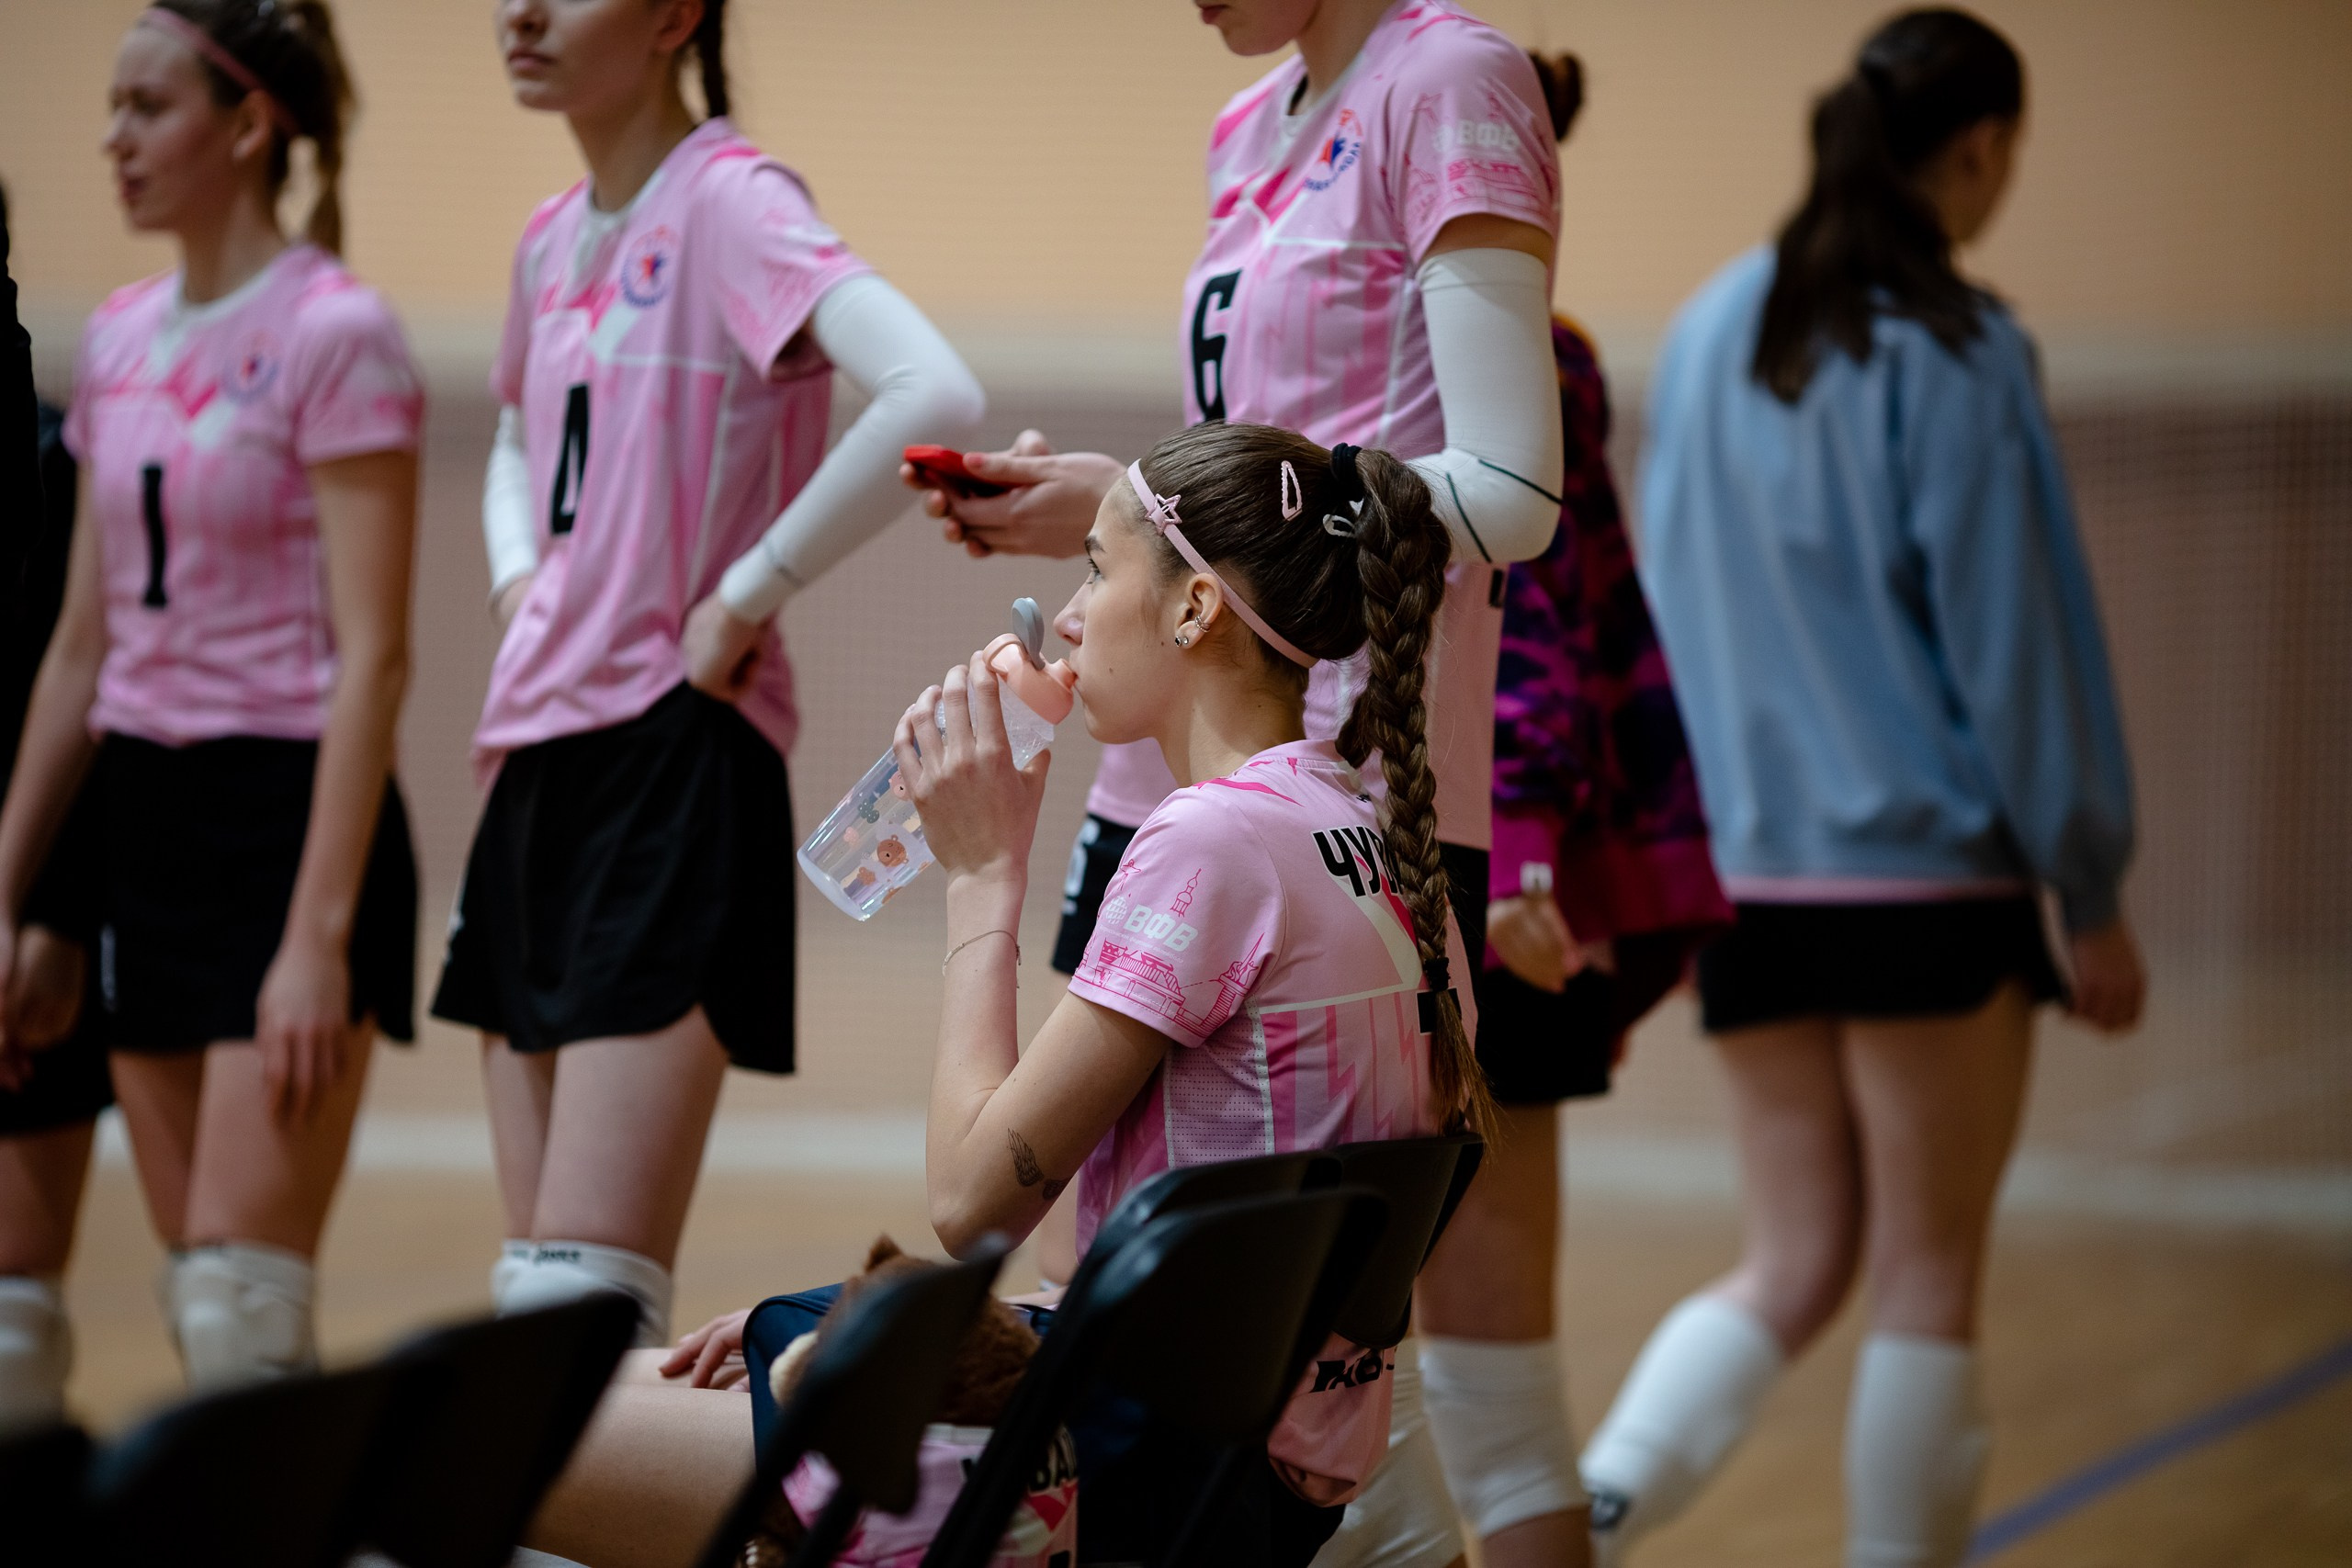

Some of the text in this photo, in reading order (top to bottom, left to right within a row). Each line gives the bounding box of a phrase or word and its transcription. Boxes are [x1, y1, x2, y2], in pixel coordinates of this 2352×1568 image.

[1193, 268, 1243, 425] 6
[141, 465, 168, 608] 1
[1123, 904, 1198, 953] ВФВ
